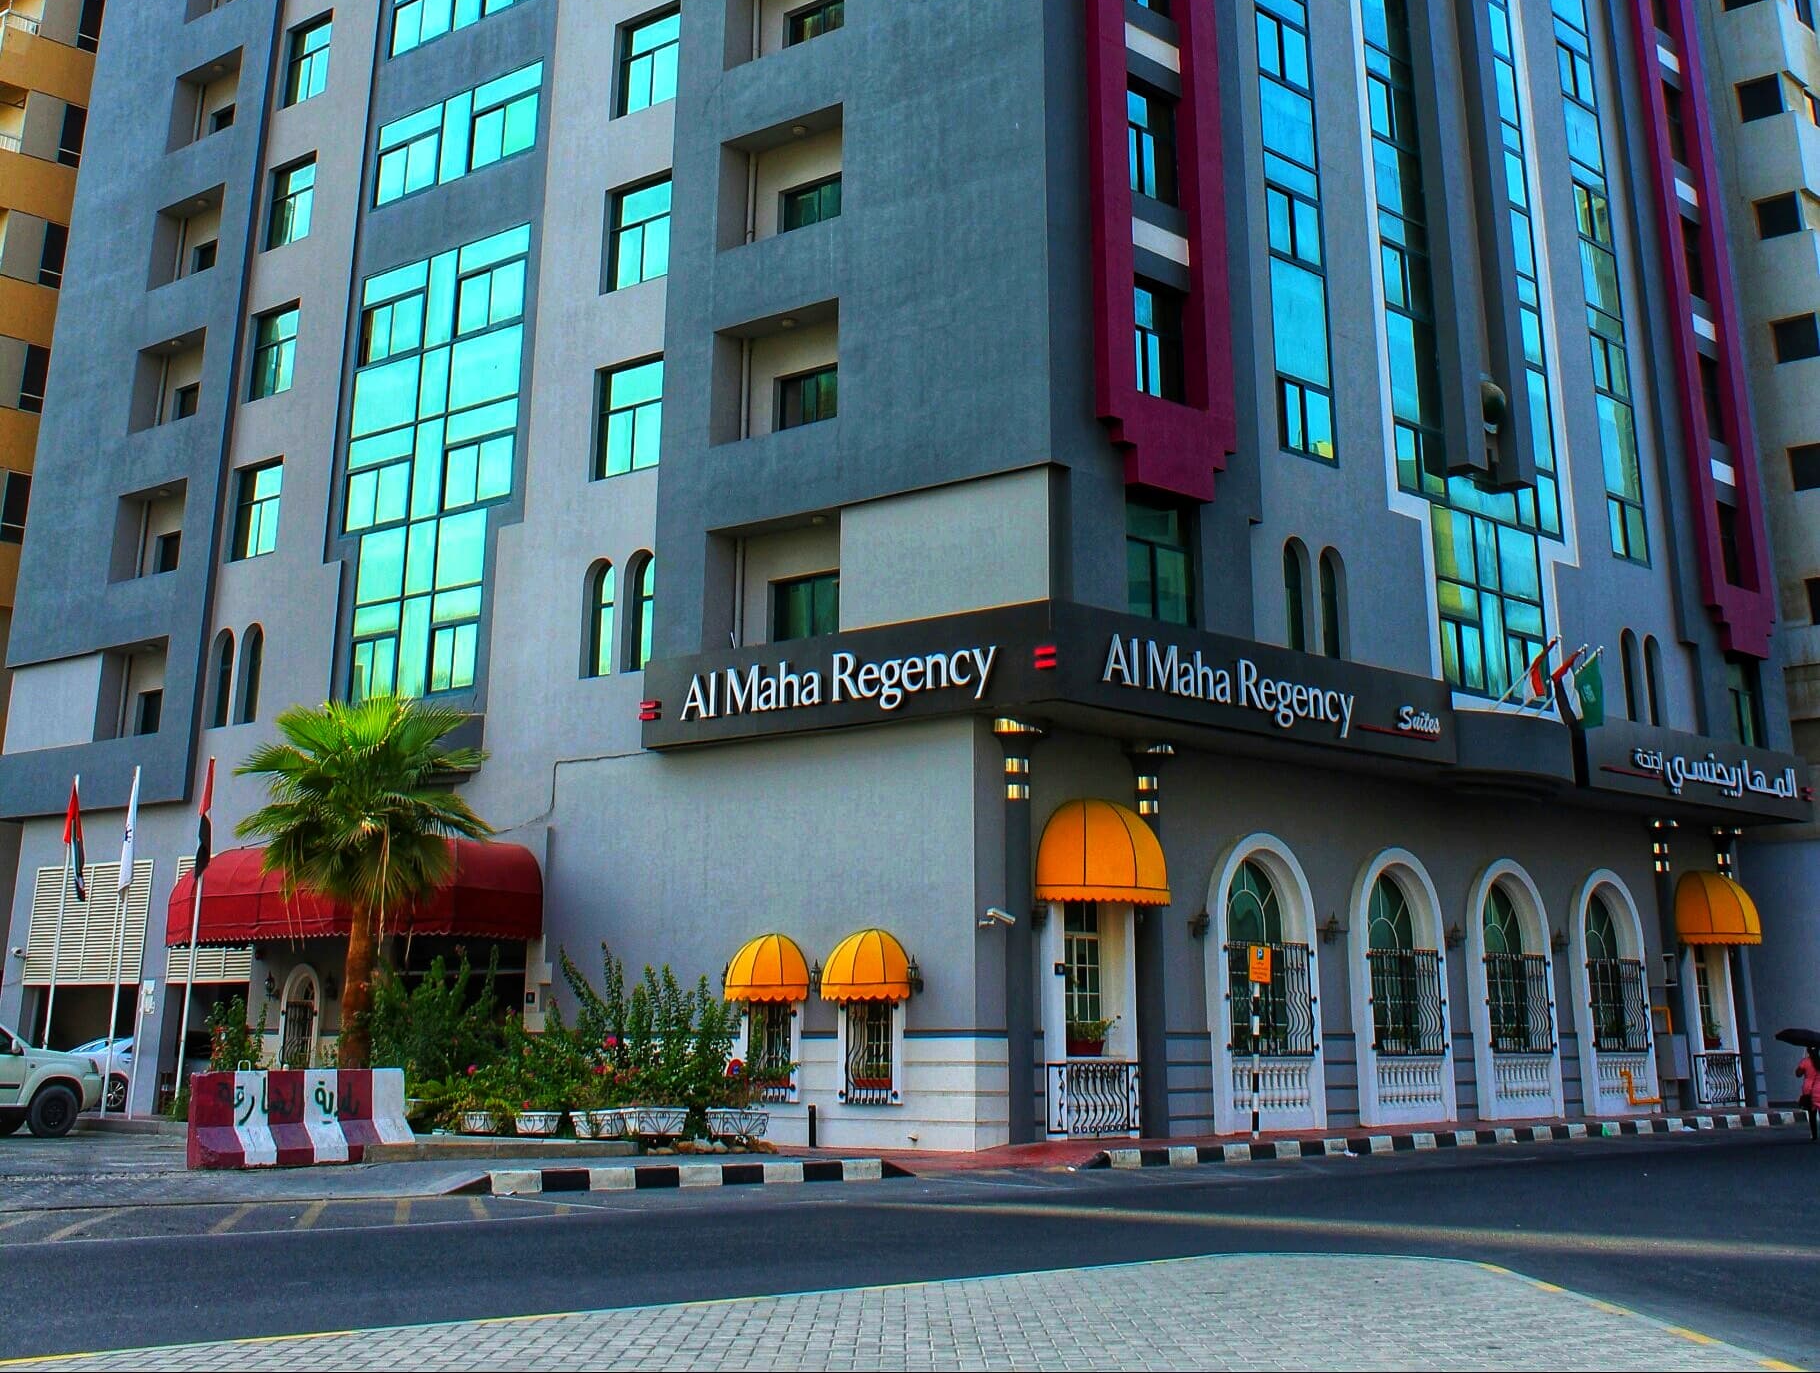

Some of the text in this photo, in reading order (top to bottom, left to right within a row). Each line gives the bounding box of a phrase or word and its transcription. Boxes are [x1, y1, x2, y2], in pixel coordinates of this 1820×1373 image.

[680, 644, 998, 721] Al Maha Regency
[1102, 633, 1355, 739] Al Maha Regency
[1397, 704, 1442, 734] Suites
